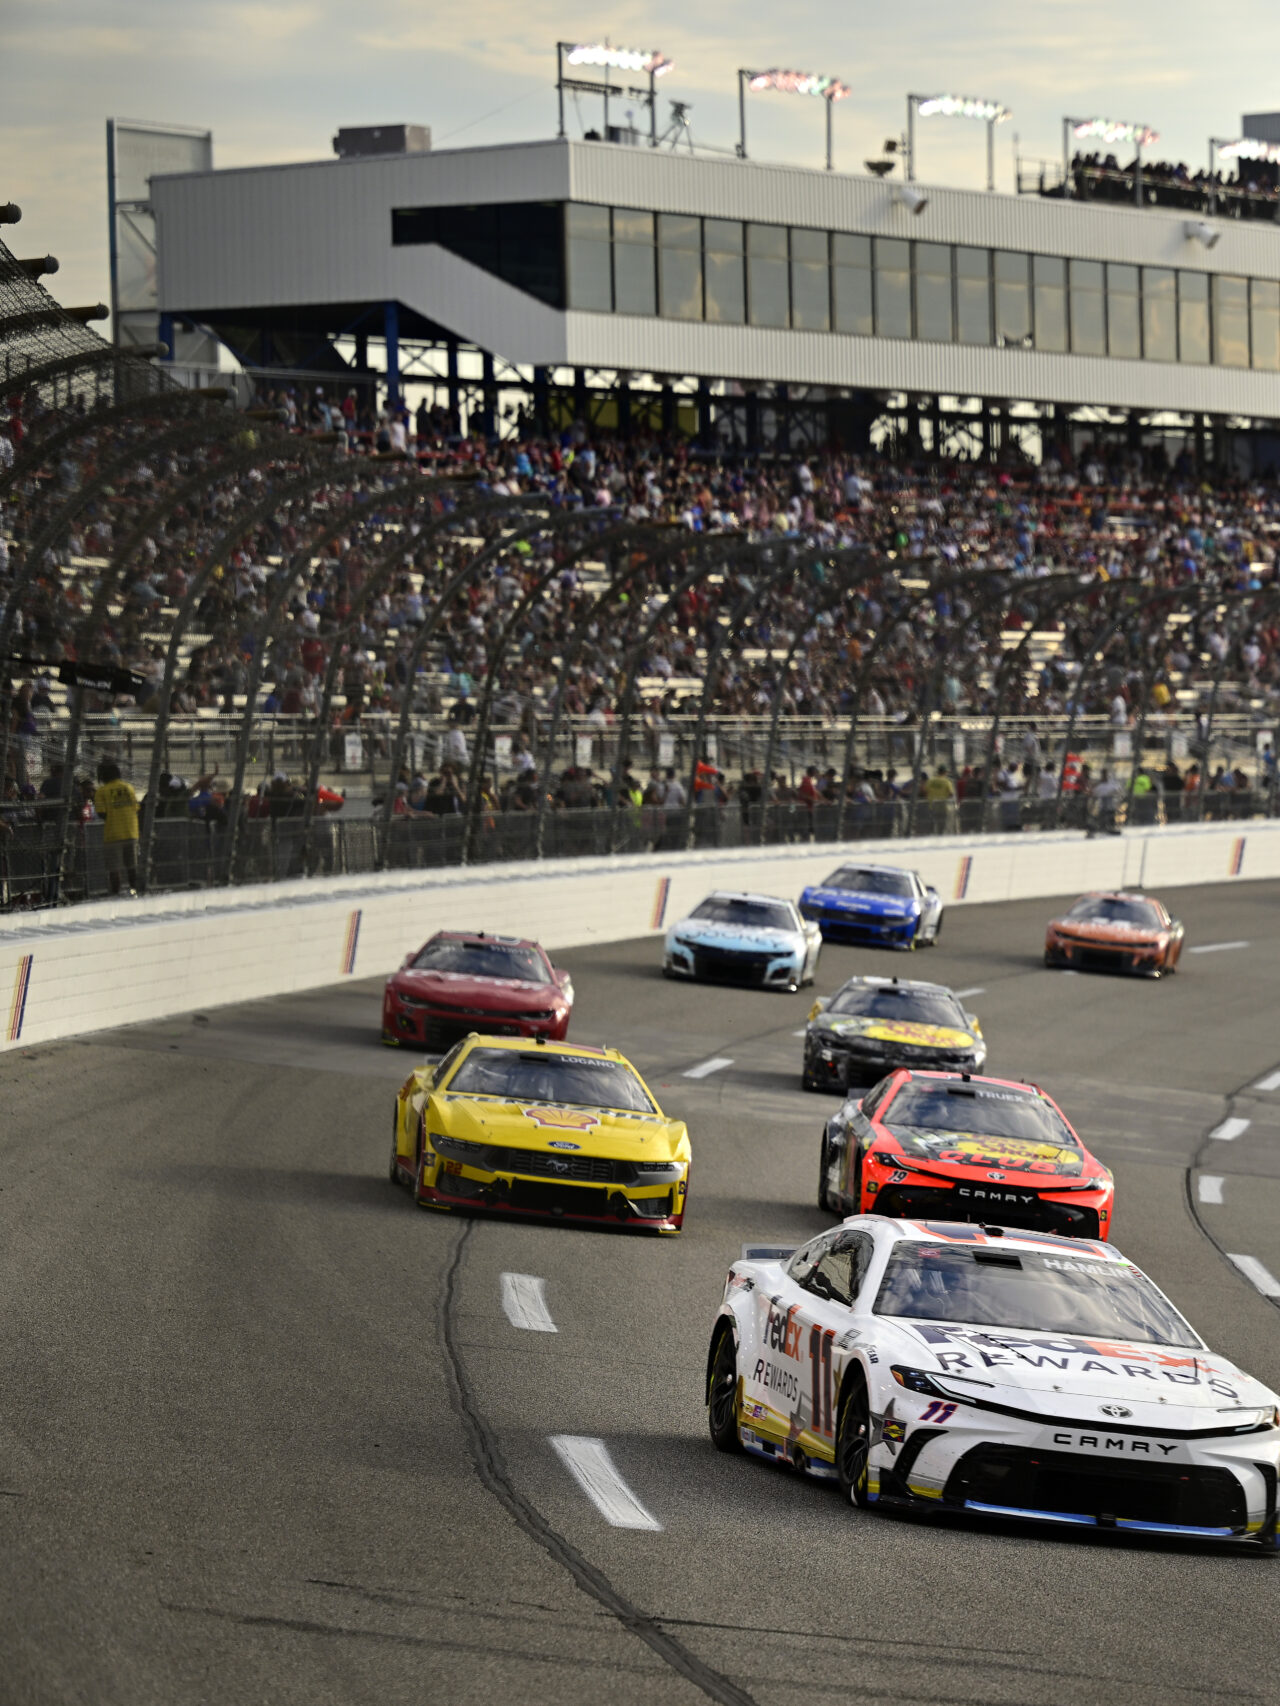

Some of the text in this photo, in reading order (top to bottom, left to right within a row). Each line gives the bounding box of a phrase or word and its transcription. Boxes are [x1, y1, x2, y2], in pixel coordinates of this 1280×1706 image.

[560, 1055, 616, 1069] LOGANO
[976, 1090, 1025, 1102] TRUEX
[446, 1161, 463, 1176] 22
[939, 1150, 1057, 1173] CLUB
[885, 1169, 909, 1184] 19
[958, 1187, 1034, 1204] CAMRY
[1043, 1257, 1133, 1279] HAMLIN
[763, 1294, 804, 1362] FedEx
[911, 1324, 1225, 1376] FedEx
[753, 1358, 799, 1403] REWARDS
[809, 1323, 837, 1439] 11
[935, 1351, 1239, 1399] REWARDS
[918, 1400, 959, 1424] 11
[1053, 1432, 1179, 1456] CAMRY
